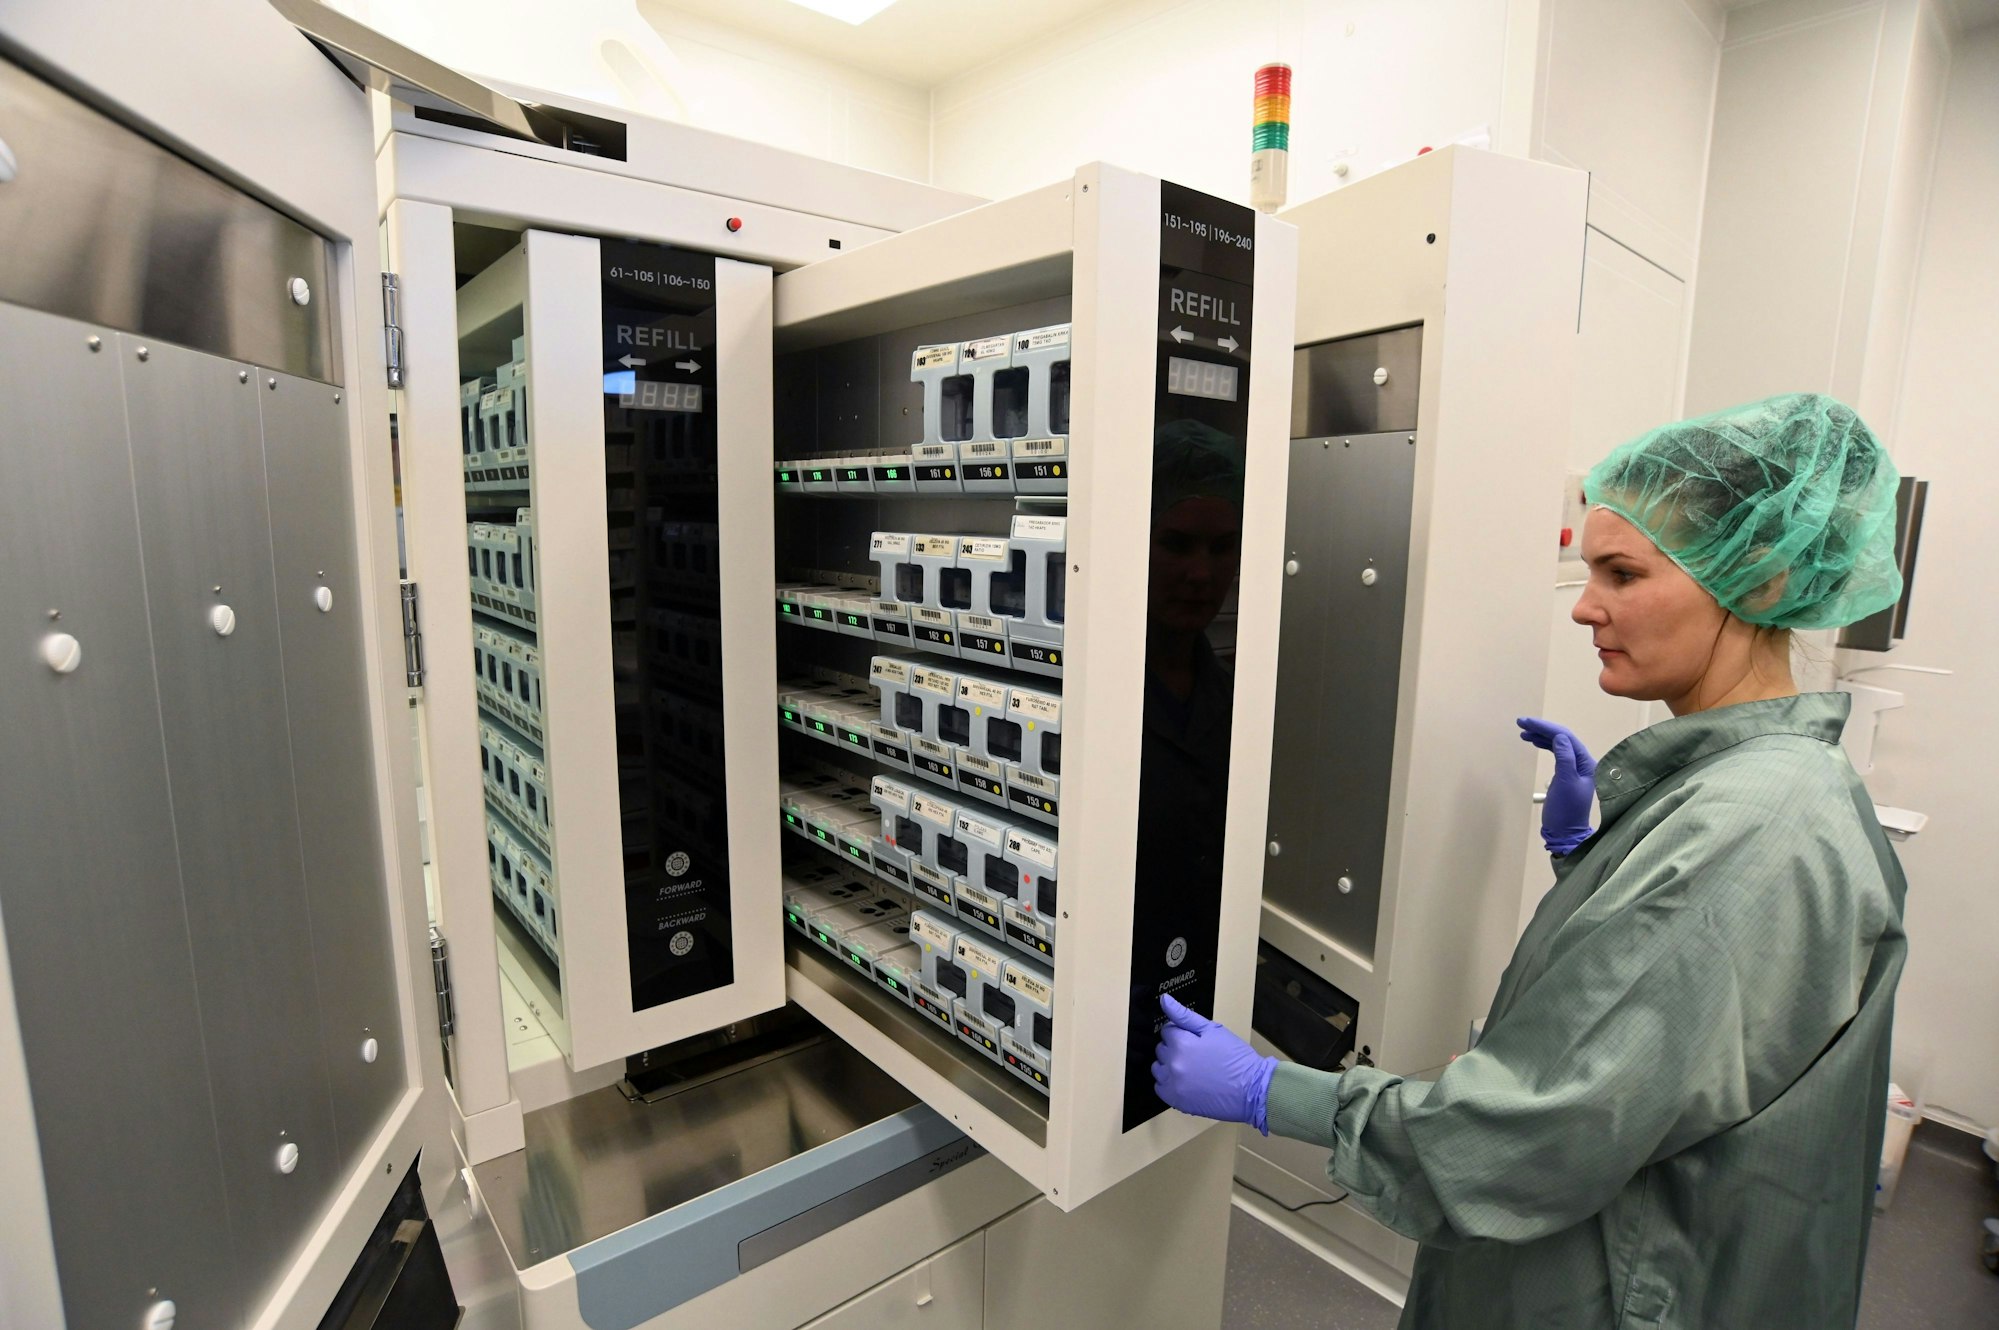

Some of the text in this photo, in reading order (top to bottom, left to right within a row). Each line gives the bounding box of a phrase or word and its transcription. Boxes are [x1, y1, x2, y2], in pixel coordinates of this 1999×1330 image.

[1170, 288, 1240, 326] REFILL
[617, 324, 702, 351] REFILL
[1018, 340, 1029, 350] 100
[848, 470, 857, 480] 171
[930, 469, 940, 478] 161
[980, 467, 992, 477] 156
[1034, 466, 1047, 476] 151
[874, 540, 882, 548] 271
[962, 544, 973, 554] 243
[814, 610, 822, 618] 177
[848, 616, 857, 625] 172
[929, 630, 939, 640] 162
[976, 638, 988, 649] 157
[1030, 649, 1043, 660] 152
[961, 686, 968, 695] 38
[1012, 698, 1020, 708] 33
[849, 734, 858, 743] 173
[928, 762, 938, 772] 163
[975, 778, 986, 789] 158
[915, 802, 921, 811] 22
[1027, 795, 1040, 808] 153
[960, 820, 969, 830] 152
[850, 847, 859, 857] 174
[659, 880, 702, 895] FORWARD
[927, 885, 938, 896] 164
[973, 908, 984, 920] 159
[658, 913, 706, 930] BACKWARD
[1023, 933, 1036, 946] 154
[1006, 973, 1016, 985] 134
[1159, 969, 1195, 992] FORWARD
[1020, 1062, 1032, 1075] 155
